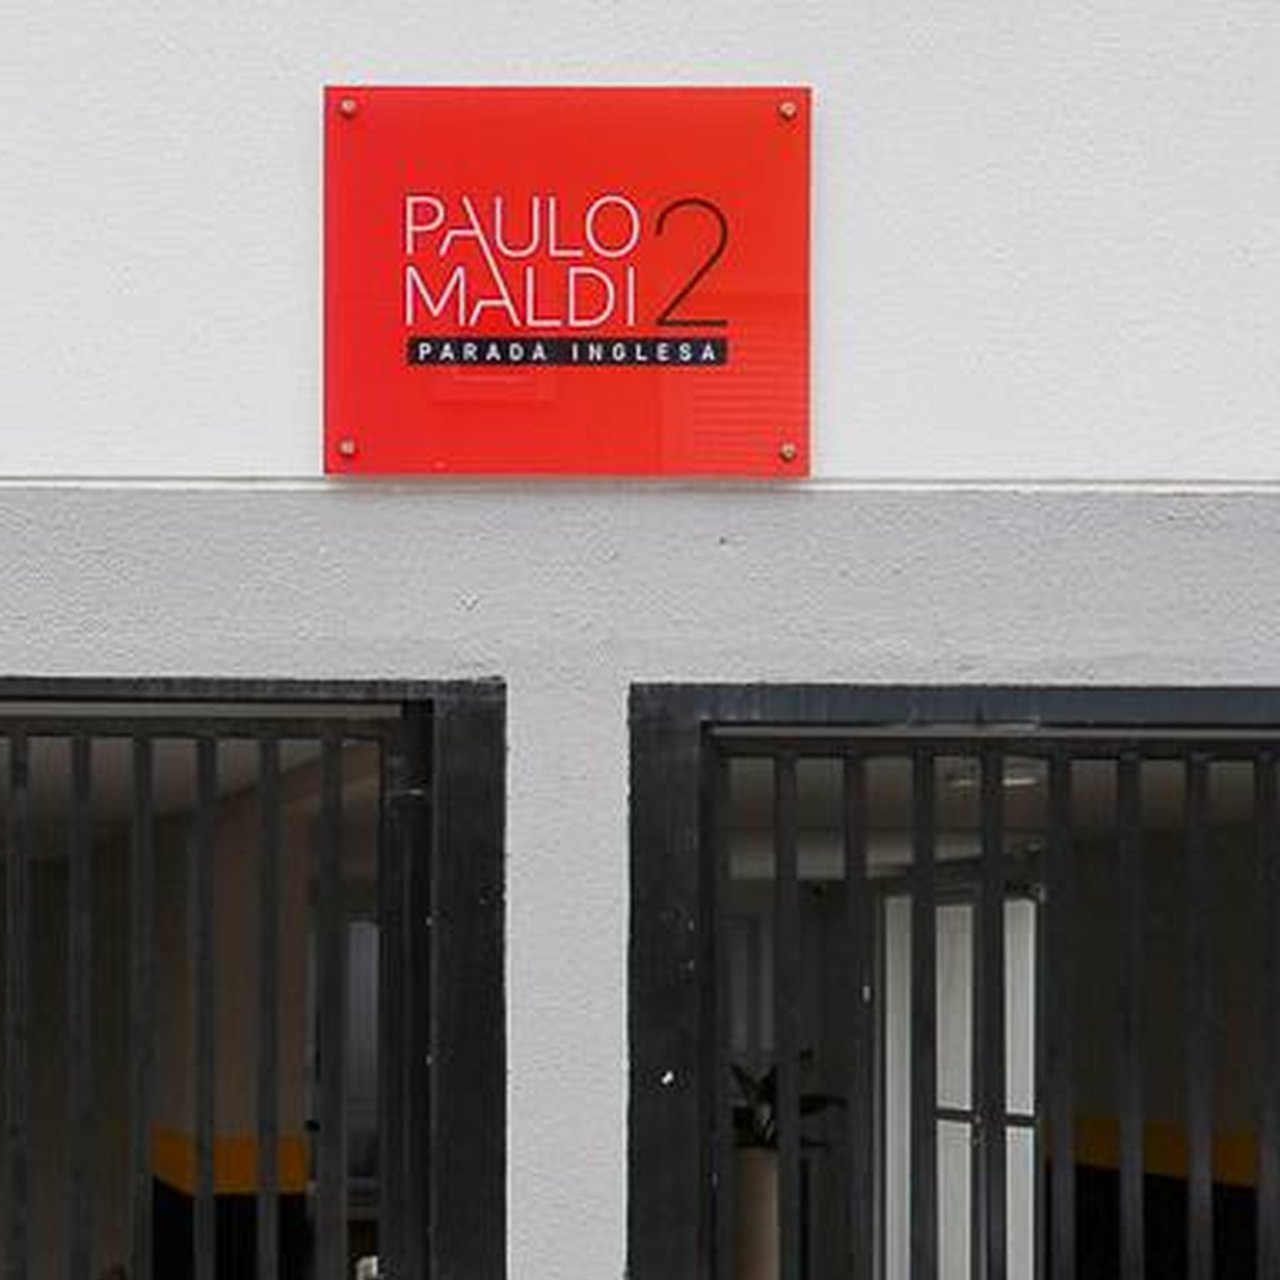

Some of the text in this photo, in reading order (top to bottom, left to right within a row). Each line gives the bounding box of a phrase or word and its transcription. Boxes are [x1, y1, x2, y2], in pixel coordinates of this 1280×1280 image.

[404, 195, 641, 258] PAULO
[654, 197, 730, 328] 2
[404, 265, 637, 328] MALDI
[417, 342, 718, 362] PARADA INGLESA
